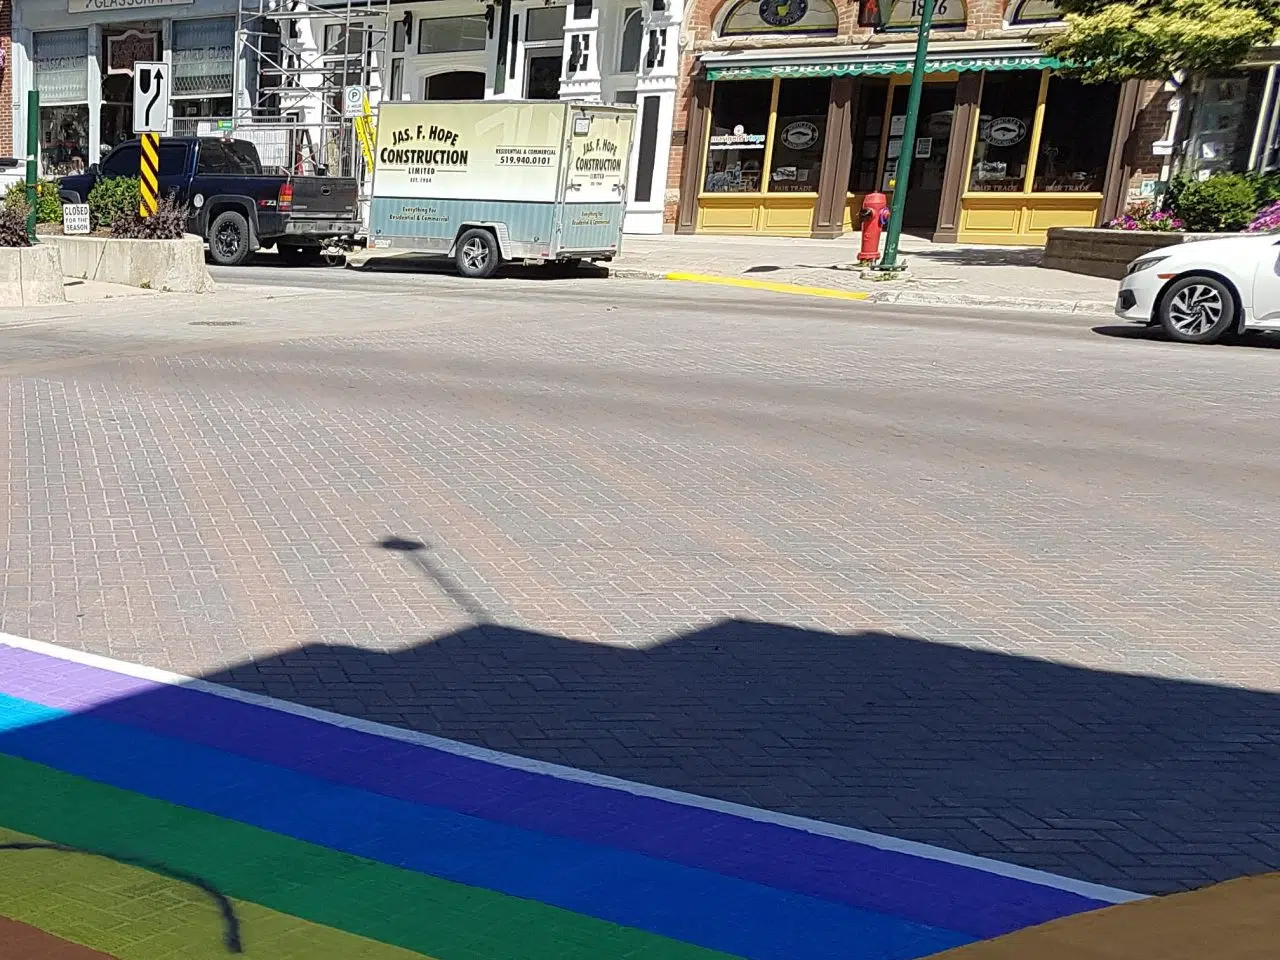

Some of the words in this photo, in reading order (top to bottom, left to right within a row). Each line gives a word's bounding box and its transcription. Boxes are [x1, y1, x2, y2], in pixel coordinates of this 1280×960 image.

[770, 62, 897, 74] SPROULE'S
[392, 128, 413, 146] JAS.
[417, 125, 425, 139] F.
[429, 125, 459, 147] HOPE
[602, 139, 617, 156] HOPE
[380, 147, 468, 165] CONSTRUCTION
[500, 156, 550, 164] 519.940.0101
[408, 167, 435, 175] LIMITED
[575, 157, 622, 172] CONSTRUCTION
[65, 206, 88, 216] CLOSED
